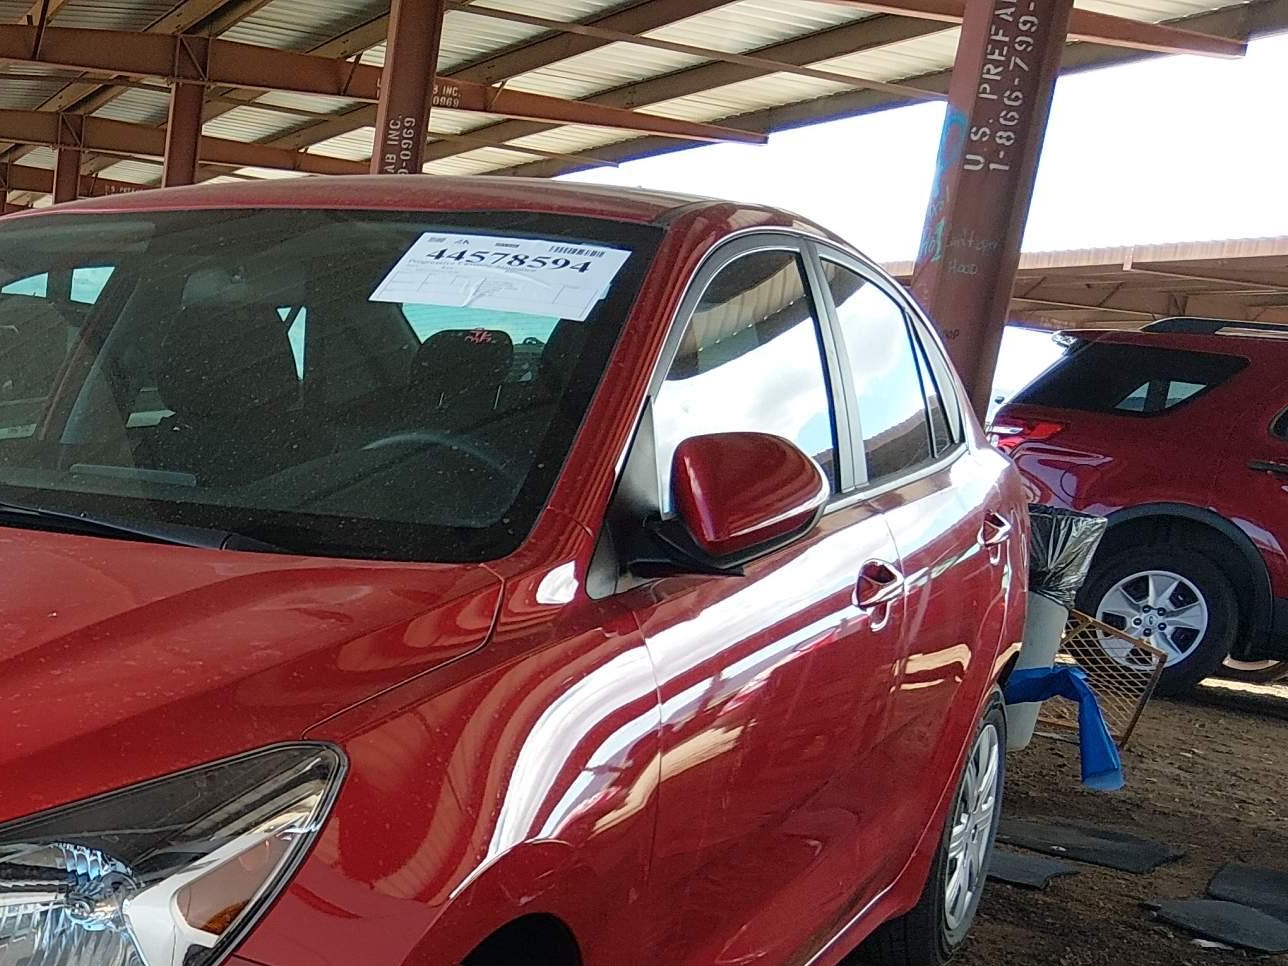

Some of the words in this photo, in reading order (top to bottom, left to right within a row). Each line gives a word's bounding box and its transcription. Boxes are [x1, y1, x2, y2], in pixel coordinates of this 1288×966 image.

[978, 0, 1015, 99] PREFA
[442, 86, 462, 98] INC.
[387, 115, 402, 145] INC.
[426, 248, 593, 273] 44578594
